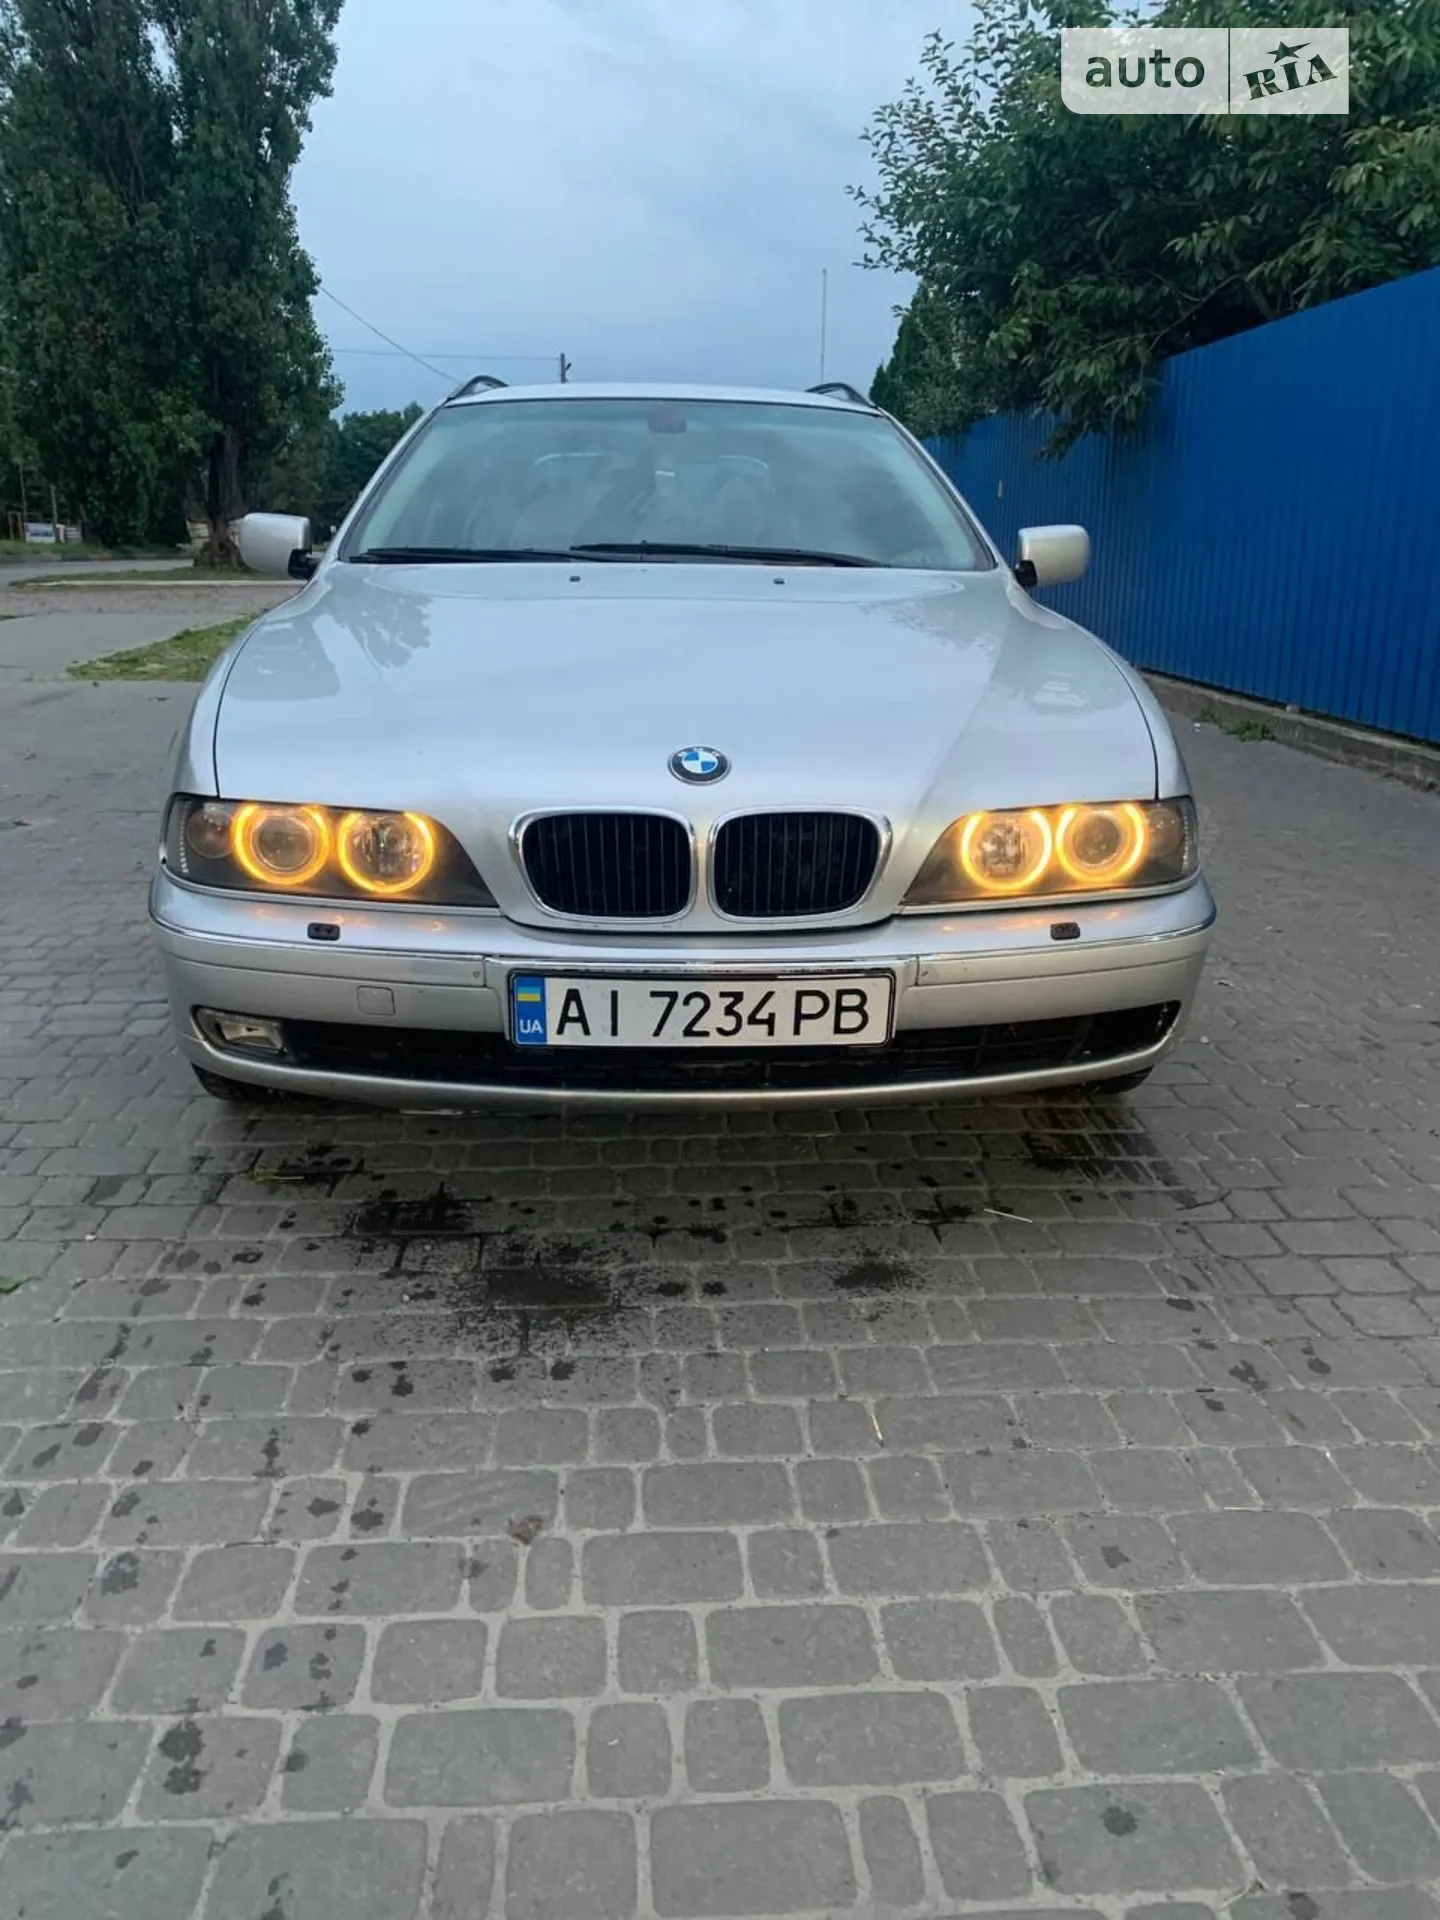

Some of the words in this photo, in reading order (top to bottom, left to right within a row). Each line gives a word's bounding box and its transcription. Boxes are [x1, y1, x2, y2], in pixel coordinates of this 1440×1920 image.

[520, 1018, 543, 1034] UA
[556, 988, 619, 1036] AI
[649, 990, 776, 1037] 7234
[793, 988, 869, 1036] PB
